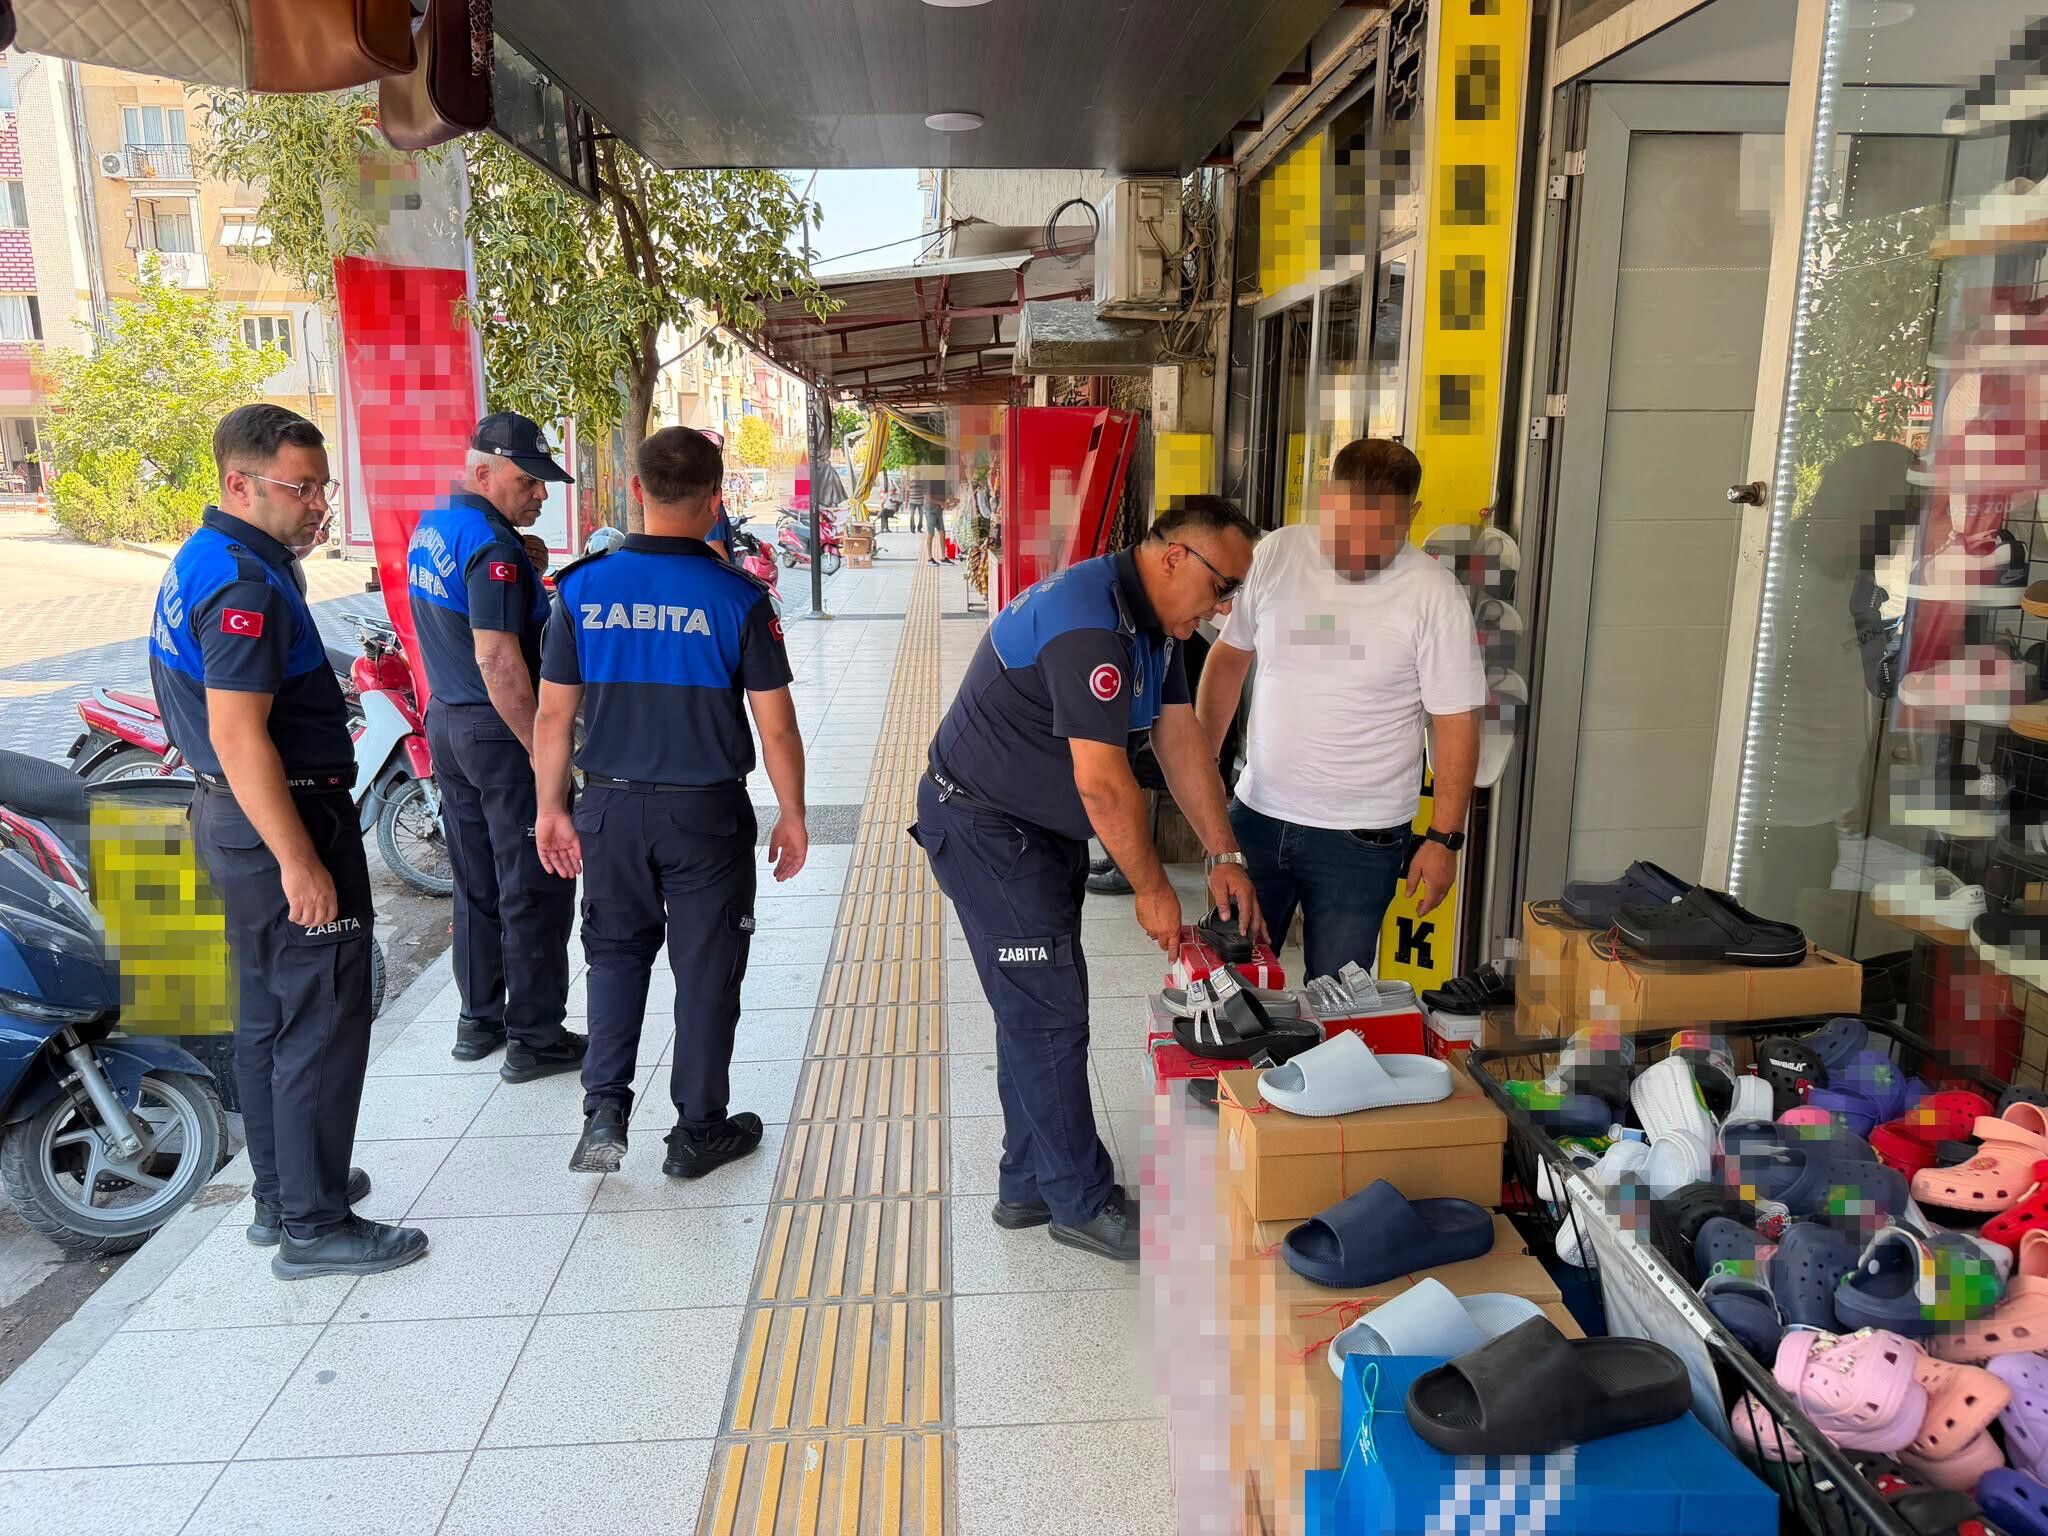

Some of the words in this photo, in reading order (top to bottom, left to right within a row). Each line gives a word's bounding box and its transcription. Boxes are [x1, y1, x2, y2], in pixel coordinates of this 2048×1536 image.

[580, 603, 711, 636] ZABITA
[304, 917, 361, 936] ZABITA
[998, 946, 1048, 962] ZABITA
